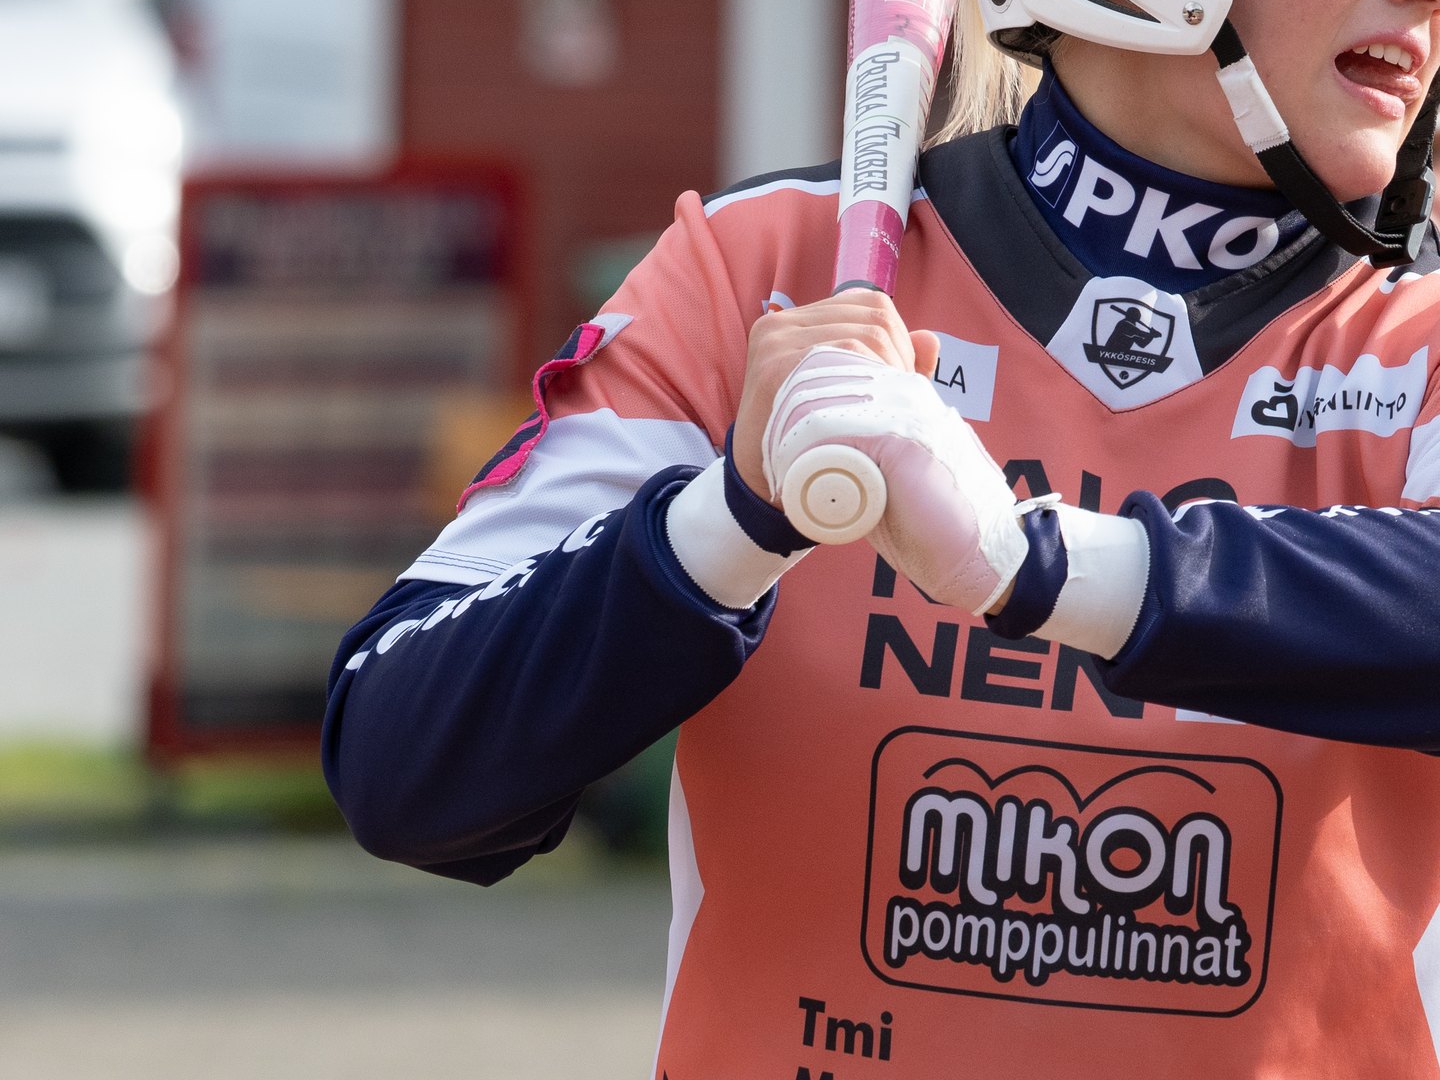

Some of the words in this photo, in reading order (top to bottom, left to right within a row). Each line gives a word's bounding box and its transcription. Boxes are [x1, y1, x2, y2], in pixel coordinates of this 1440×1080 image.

[1099, 350, 1157, 366] YKKÖSPESIS
[890, 903, 1243, 980] pomppulinnat
[799, 996, 894, 1062] Tmi
